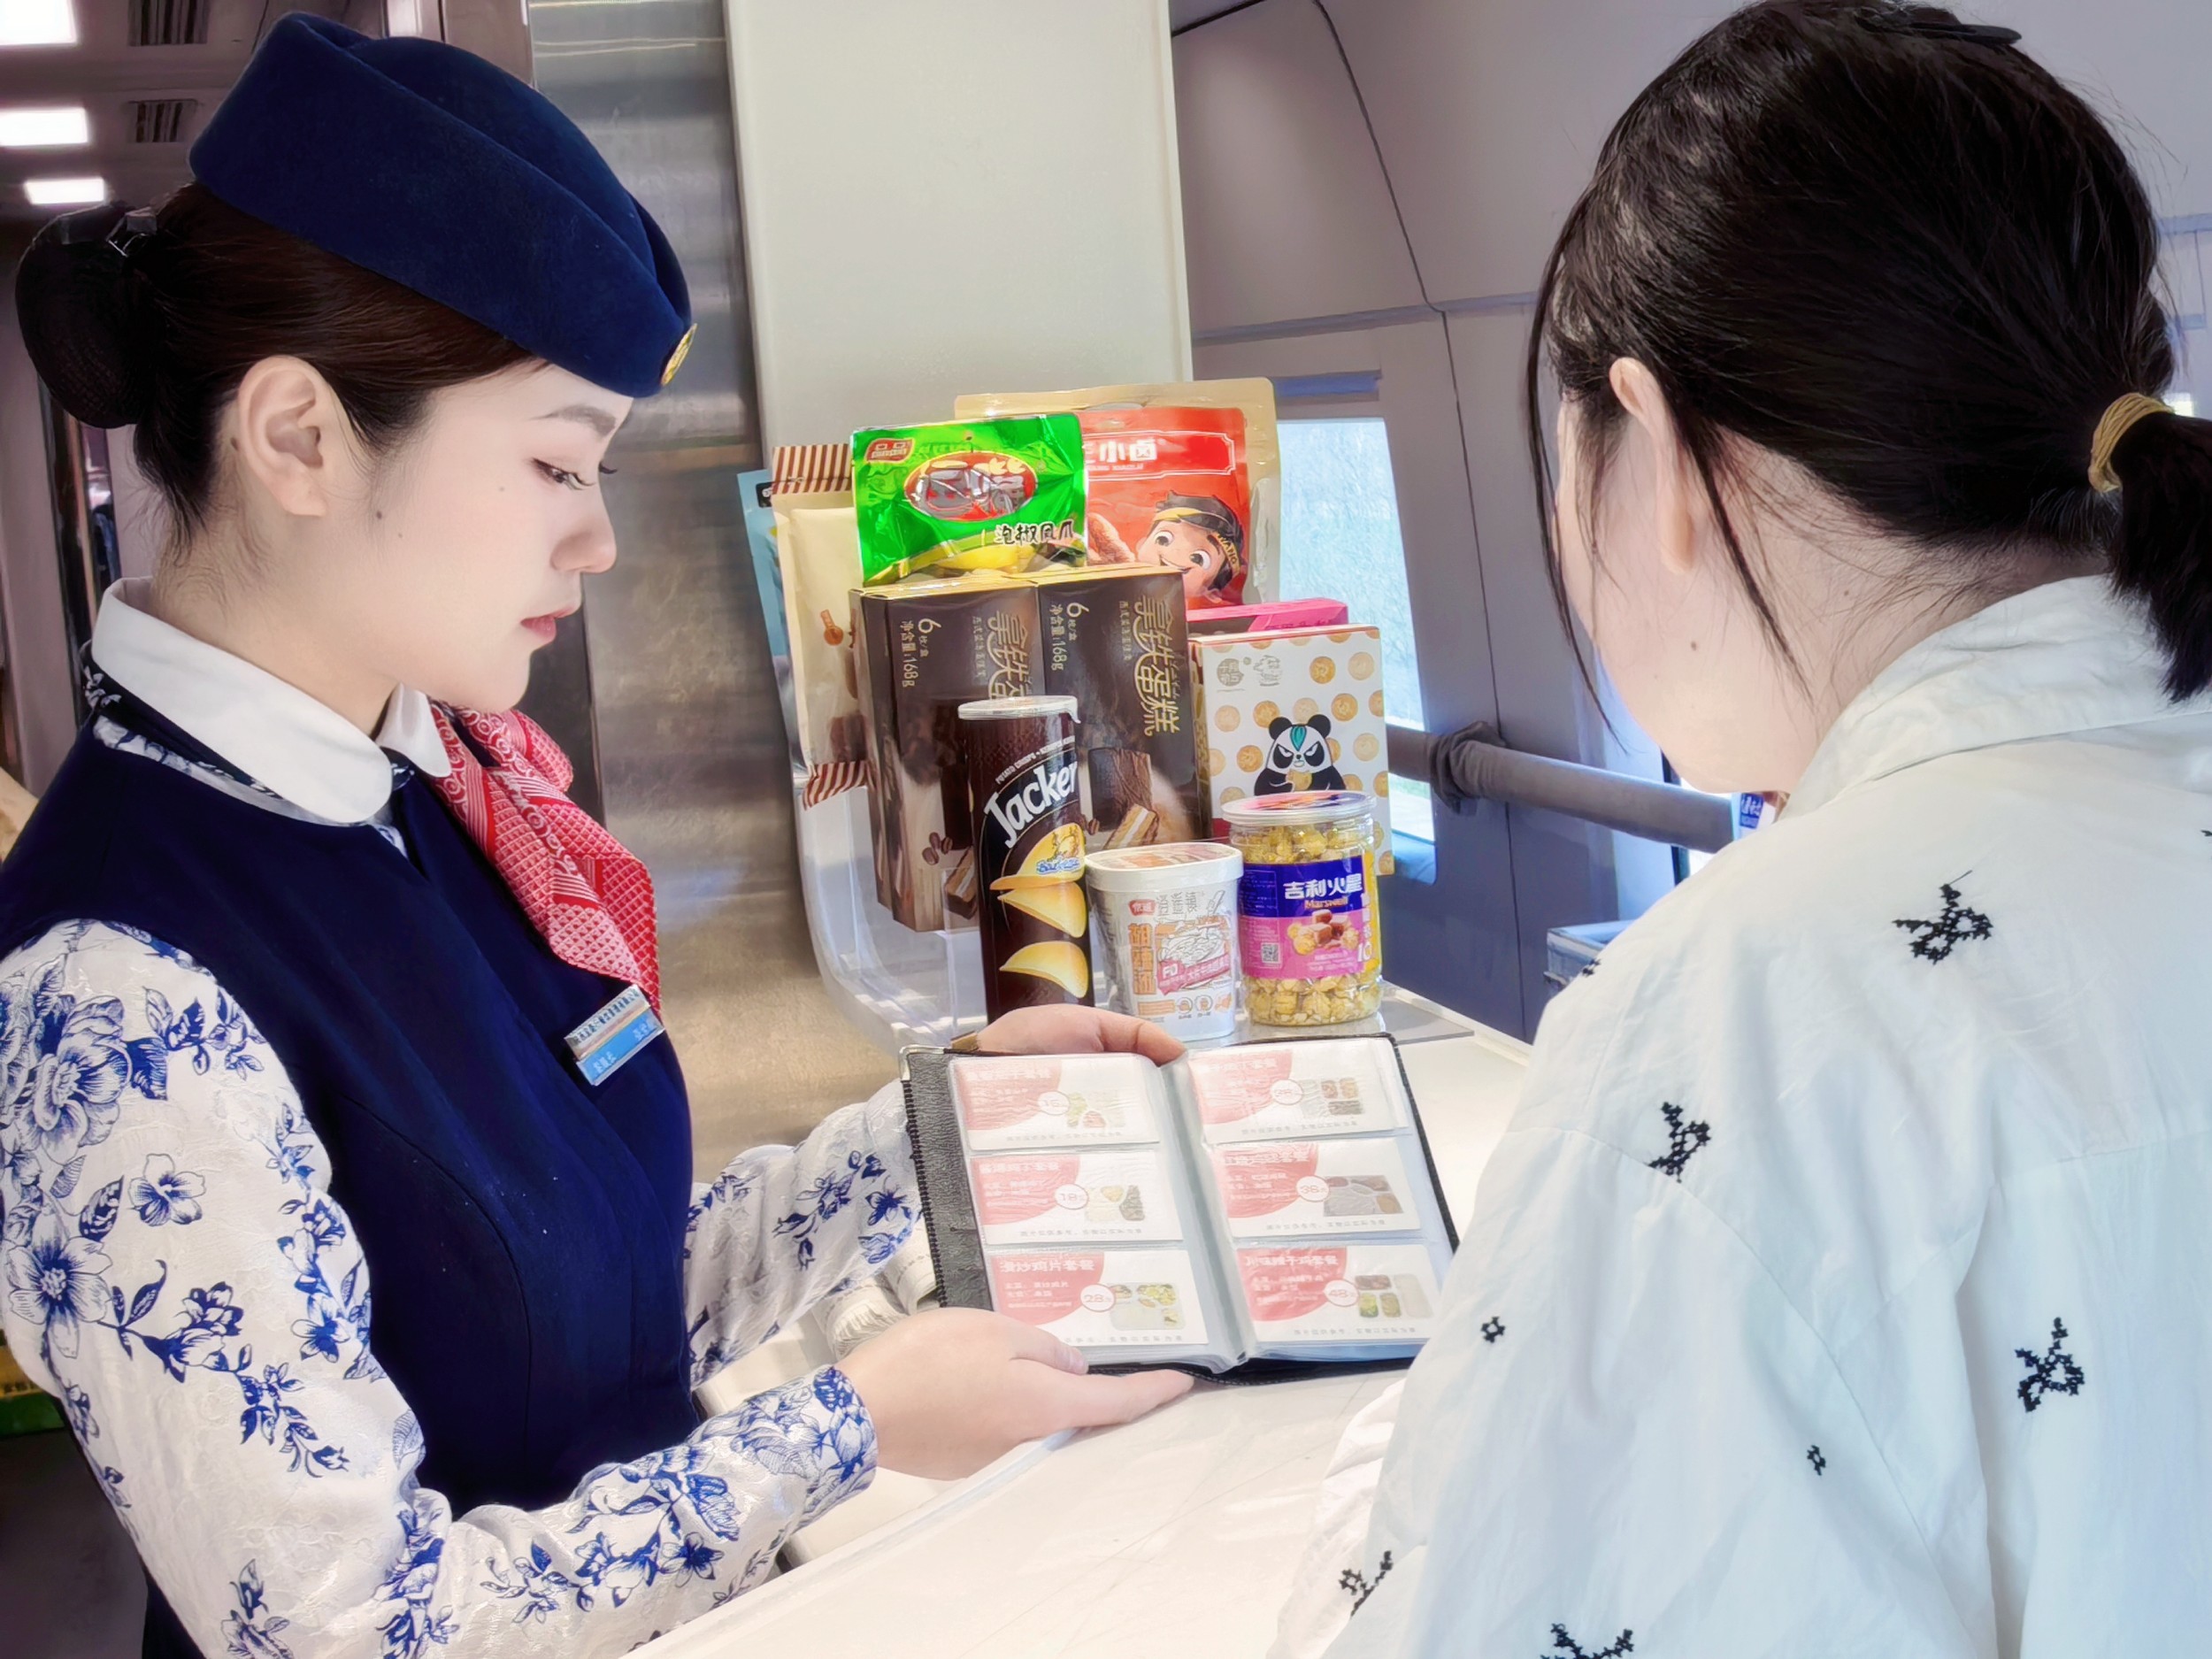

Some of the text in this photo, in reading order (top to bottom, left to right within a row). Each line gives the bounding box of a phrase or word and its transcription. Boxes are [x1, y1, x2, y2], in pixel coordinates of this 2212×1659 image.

[994, 519, 1074, 546] 泡椒凤爪
[1133, 595, 1181, 737] 拿铁蛋糕
[983, 760, 1078, 849] Jacker
[1282, 872, 1363, 900] 吉利火星
